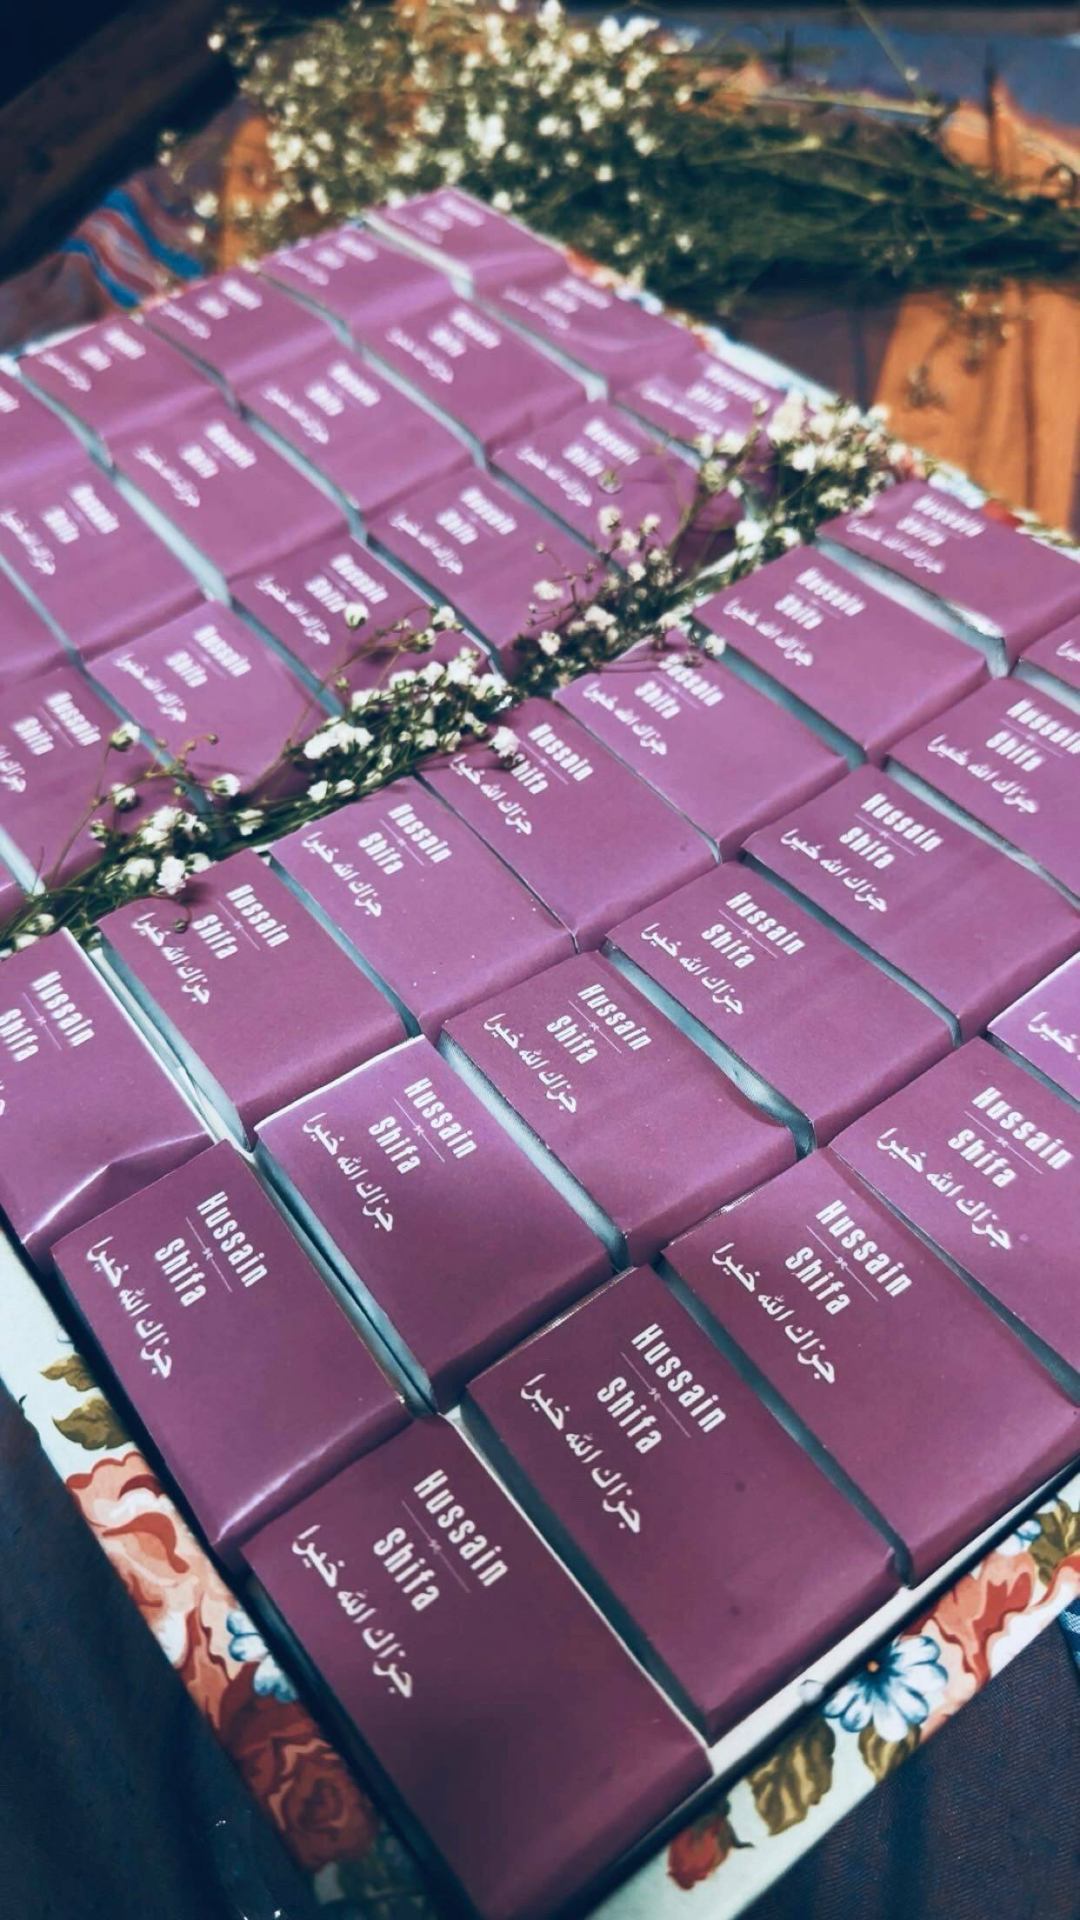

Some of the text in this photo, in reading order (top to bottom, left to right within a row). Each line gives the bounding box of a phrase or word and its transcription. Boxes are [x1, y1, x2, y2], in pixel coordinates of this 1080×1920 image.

[527, 723, 594, 782] Hussain
[357, 831, 404, 875] Shifa
[387, 803, 452, 864] Hussain
[839, 826, 895, 869] Shifa
[860, 792, 943, 853] Hussain
[191, 914, 238, 960] Shifa
[225, 884, 290, 948] Hussain
[701, 923, 756, 969] Shifa
[725, 891, 806, 955] Hussain
[31, 970, 95, 1047] Hussain
[577, 983, 652, 1051] Hussain
[546, 1015, 598, 1065] Shifa
[368, 1115, 421, 1174] Shifa
[403, 1077, 477, 1159] Hussain
[971, 1086, 1073, 1170] Hussain
[336, 1156, 369, 1180] الله
[926, 1172, 965, 1197] الله
[947, 1128, 1017, 1188] Shifa
[196, 1191, 268, 1288] Hussain
[815, 1199, 913, 1297] Hussain
[154, 1237, 207, 1307] Shifa
[784, 1246, 851, 1315] Shifa
[118, 1289, 151, 1317] الله
[757, 1294, 795, 1322] الله
[631, 1323, 727, 1433] Hussain
[596, 1376, 662, 1454] Shifa
[565, 1433, 603, 1464] الله
[413, 1469, 508, 1587] Hussain
[373, 1527, 440, 1612] Shifa
[337, 1590, 376, 1624] الله
